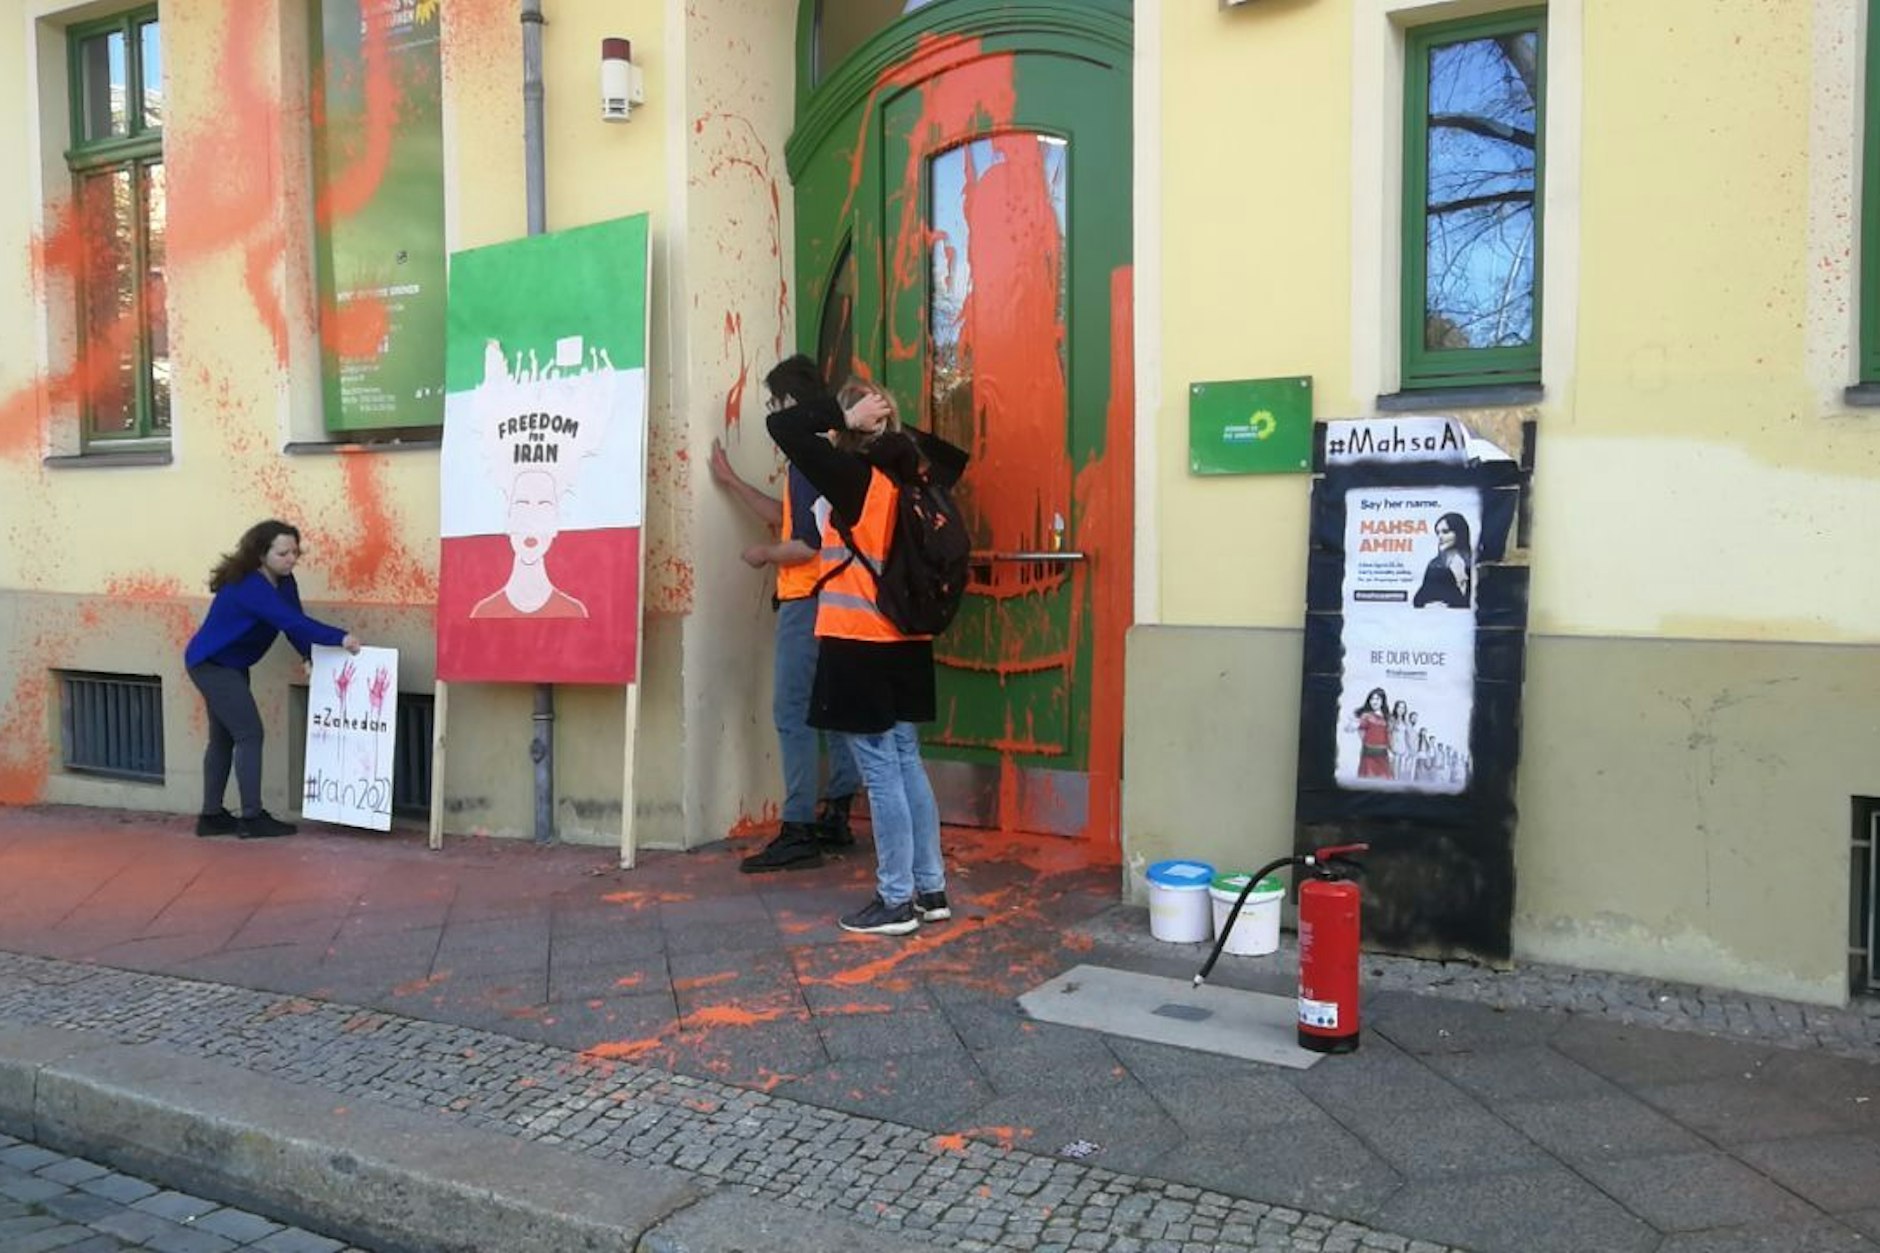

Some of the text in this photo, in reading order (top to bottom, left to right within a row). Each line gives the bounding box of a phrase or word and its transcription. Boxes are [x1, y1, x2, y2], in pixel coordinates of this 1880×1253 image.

[498, 412, 579, 439] FREEDOM
[529, 432, 545, 441] FOR
[514, 443, 558, 463] IRAN
[1361, 498, 1442, 511] Say her name.
[1360, 519, 1428, 535] MAHSA
[1359, 539, 1413, 552] AMINI
[1370, 650, 1446, 666] BE OUR VOICE
[313, 708, 387, 732] #Zahedan
